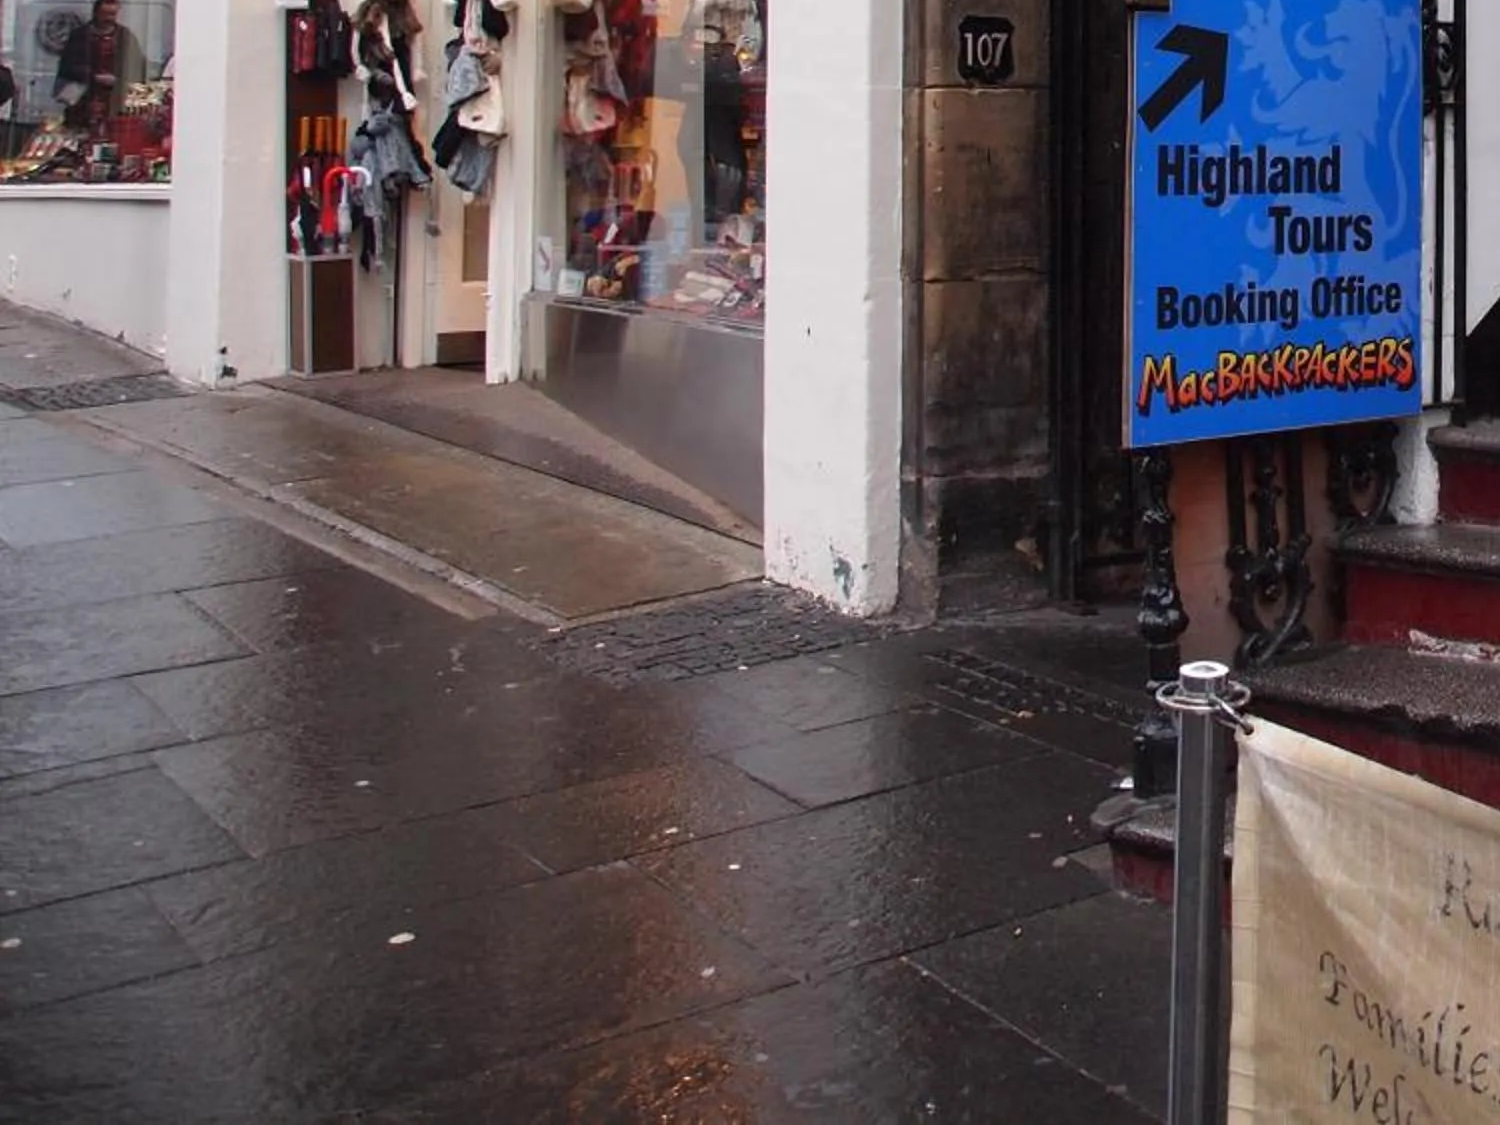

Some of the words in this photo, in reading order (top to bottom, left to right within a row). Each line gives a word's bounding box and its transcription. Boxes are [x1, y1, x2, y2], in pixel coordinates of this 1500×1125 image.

[964, 32, 1006, 67] 107
[1156, 144, 1341, 207] Highland
[1268, 207, 1373, 255] Tours
[1156, 282, 1298, 330] Booking
[1311, 275, 1401, 319] Office
[1137, 336, 1416, 416] MacBACKPACKERS
[1319, 1043, 1413, 1125] Wel
